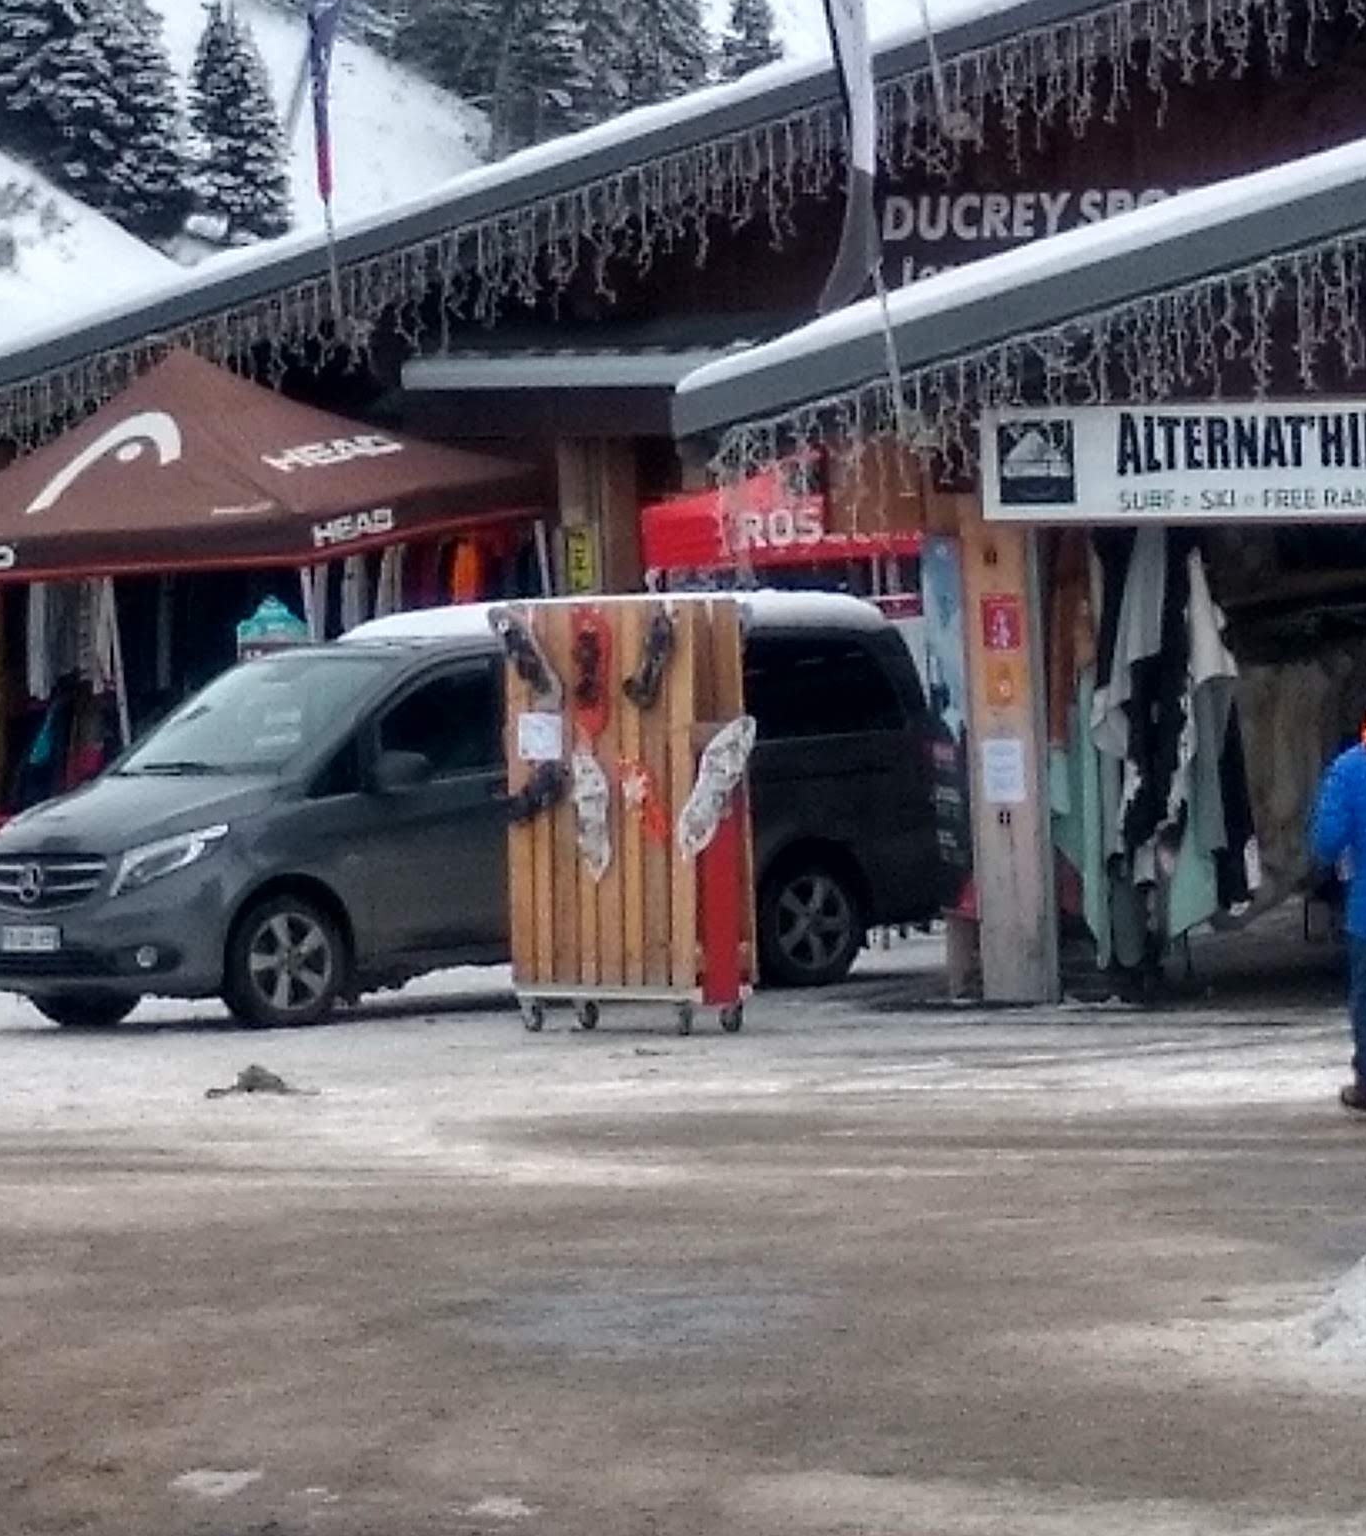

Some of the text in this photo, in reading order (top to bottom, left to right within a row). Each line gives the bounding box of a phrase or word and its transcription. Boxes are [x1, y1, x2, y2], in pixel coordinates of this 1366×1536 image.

[883, 190, 1072, 242] DUCREY
[261, 432, 404, 475] HEAD
[1117, 489, 1176, 512] SURF
[1200, 489, 1236, 511] SKI
[1262, 489, 1317, 510] FREE
[312, 507, 394, 547] HEAD
